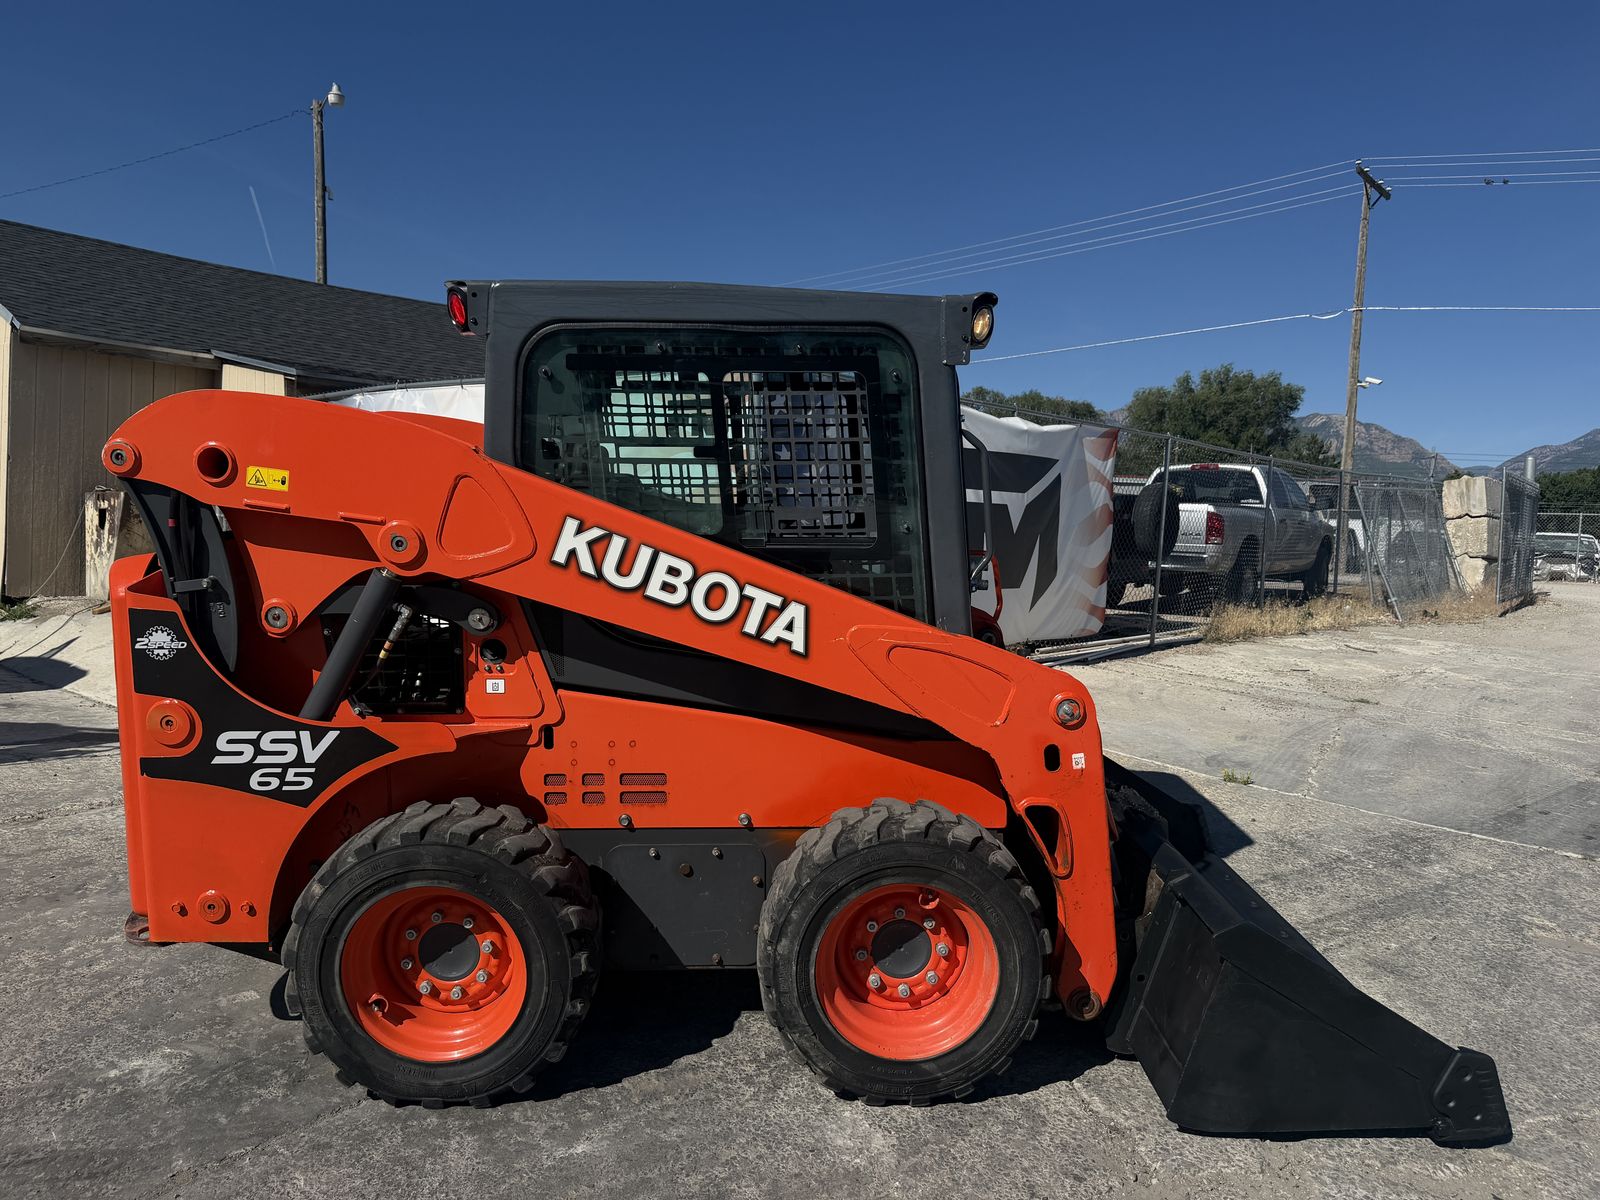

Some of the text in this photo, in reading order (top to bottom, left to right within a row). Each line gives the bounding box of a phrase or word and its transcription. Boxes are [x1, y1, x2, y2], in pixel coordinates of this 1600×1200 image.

[551, 516, 807, 656] KUBOTA
[211, 731, 340, 764] SSV
[249, 768, 315, 791] 65
